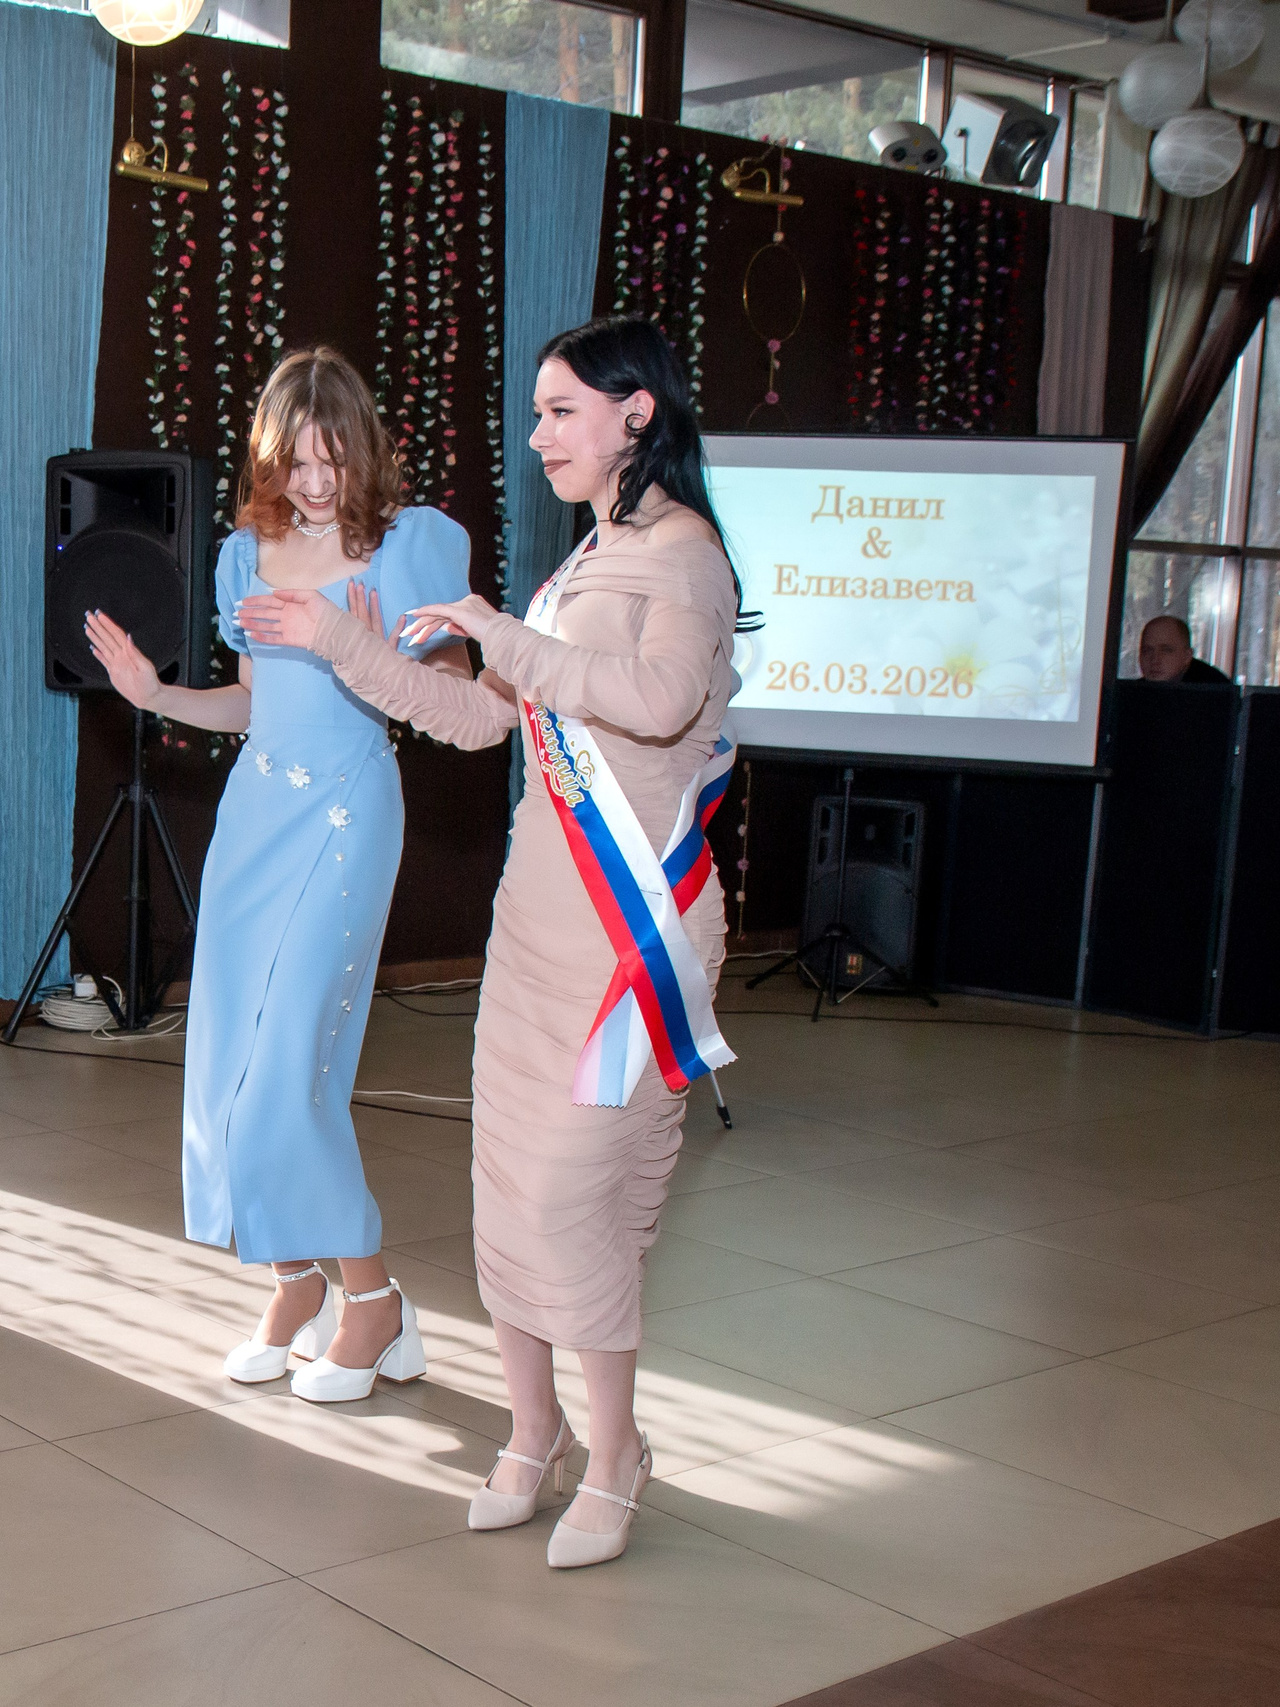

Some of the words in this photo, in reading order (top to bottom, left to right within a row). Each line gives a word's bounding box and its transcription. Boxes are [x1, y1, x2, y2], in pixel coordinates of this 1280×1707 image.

[811, 485, 946, 525] Данил
[860, 526, 892, 559] &
[772, 564, 977, 602] Елизавета
[766, 660, 975, 699] 26.03.2026
